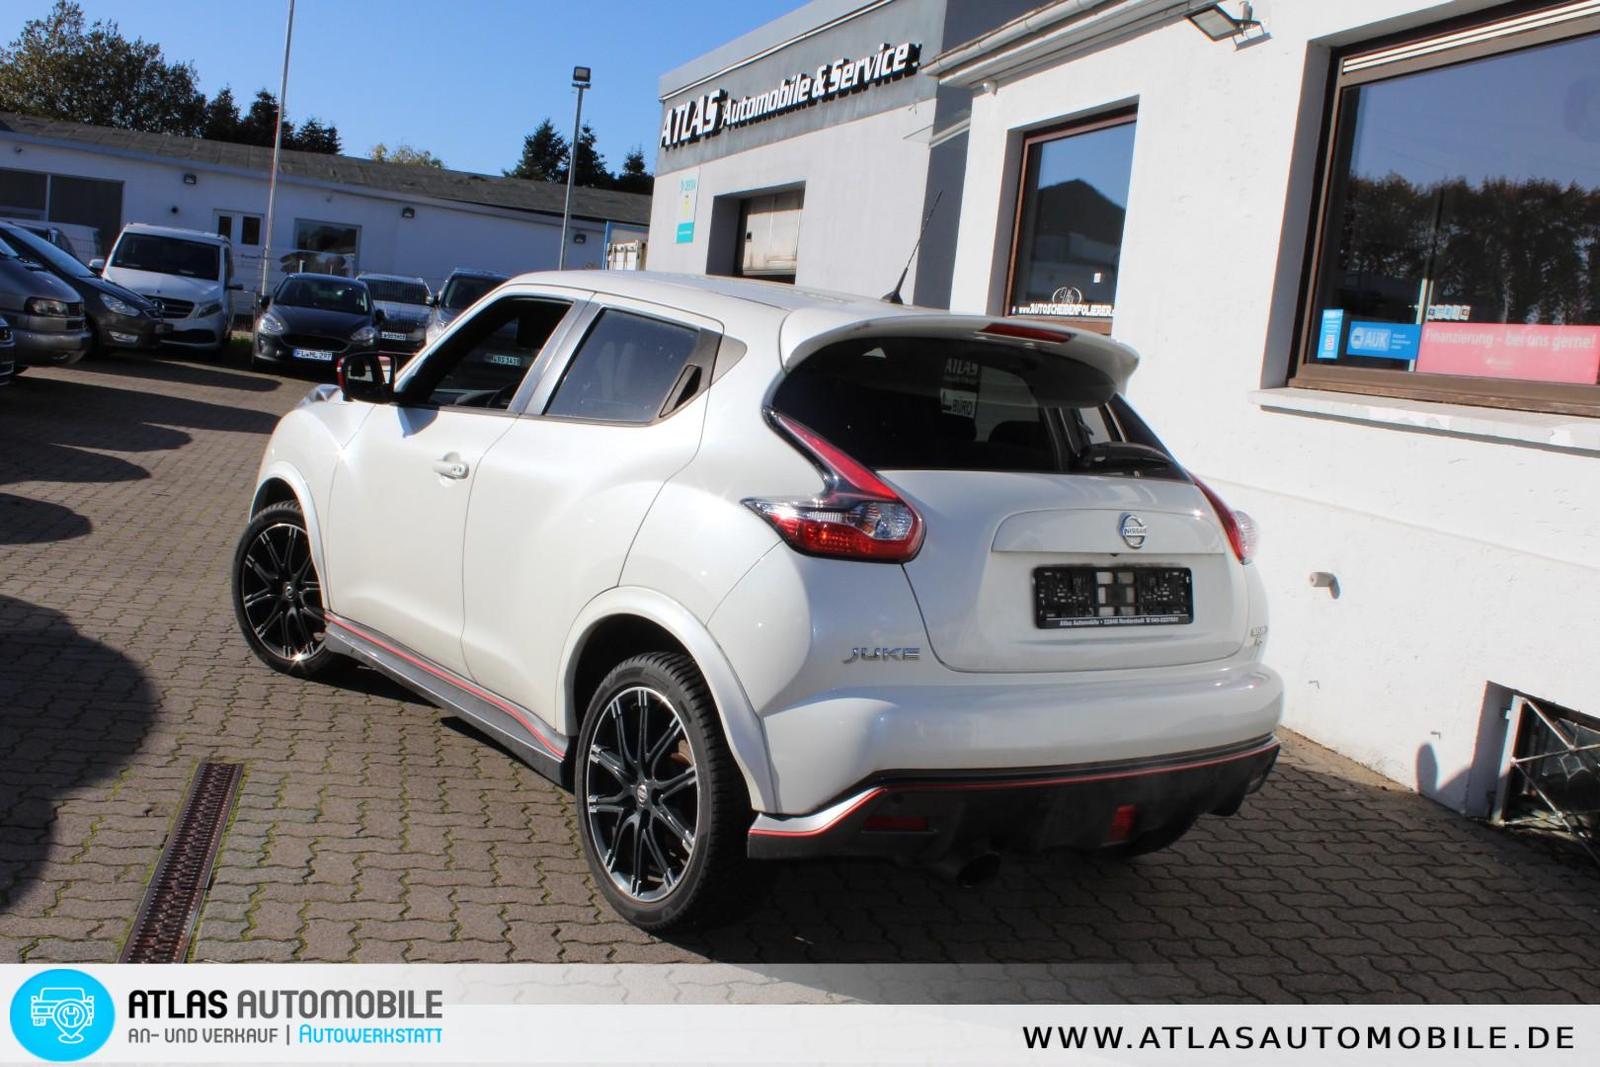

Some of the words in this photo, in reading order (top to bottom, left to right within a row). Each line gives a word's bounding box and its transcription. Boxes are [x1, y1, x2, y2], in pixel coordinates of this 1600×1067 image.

[660, 89, 720, 149] ATLAS
[720, 74, 810, 129] Automobile
[812, 65, 829, 99] &
[829, 43, 910, 93] Service
[1425, 328, 1493, 348] Finanzierung
[1506, 331, 1526, 346] bei
[1528, 334, 1549, 347] uns
[1553, 332, 1596, 352] gerne!
[944, 358, 979, 376] ATLAS
[1123, 526, 1147, 536] NISSAN
[842, 647, 921, 664] JUKE
